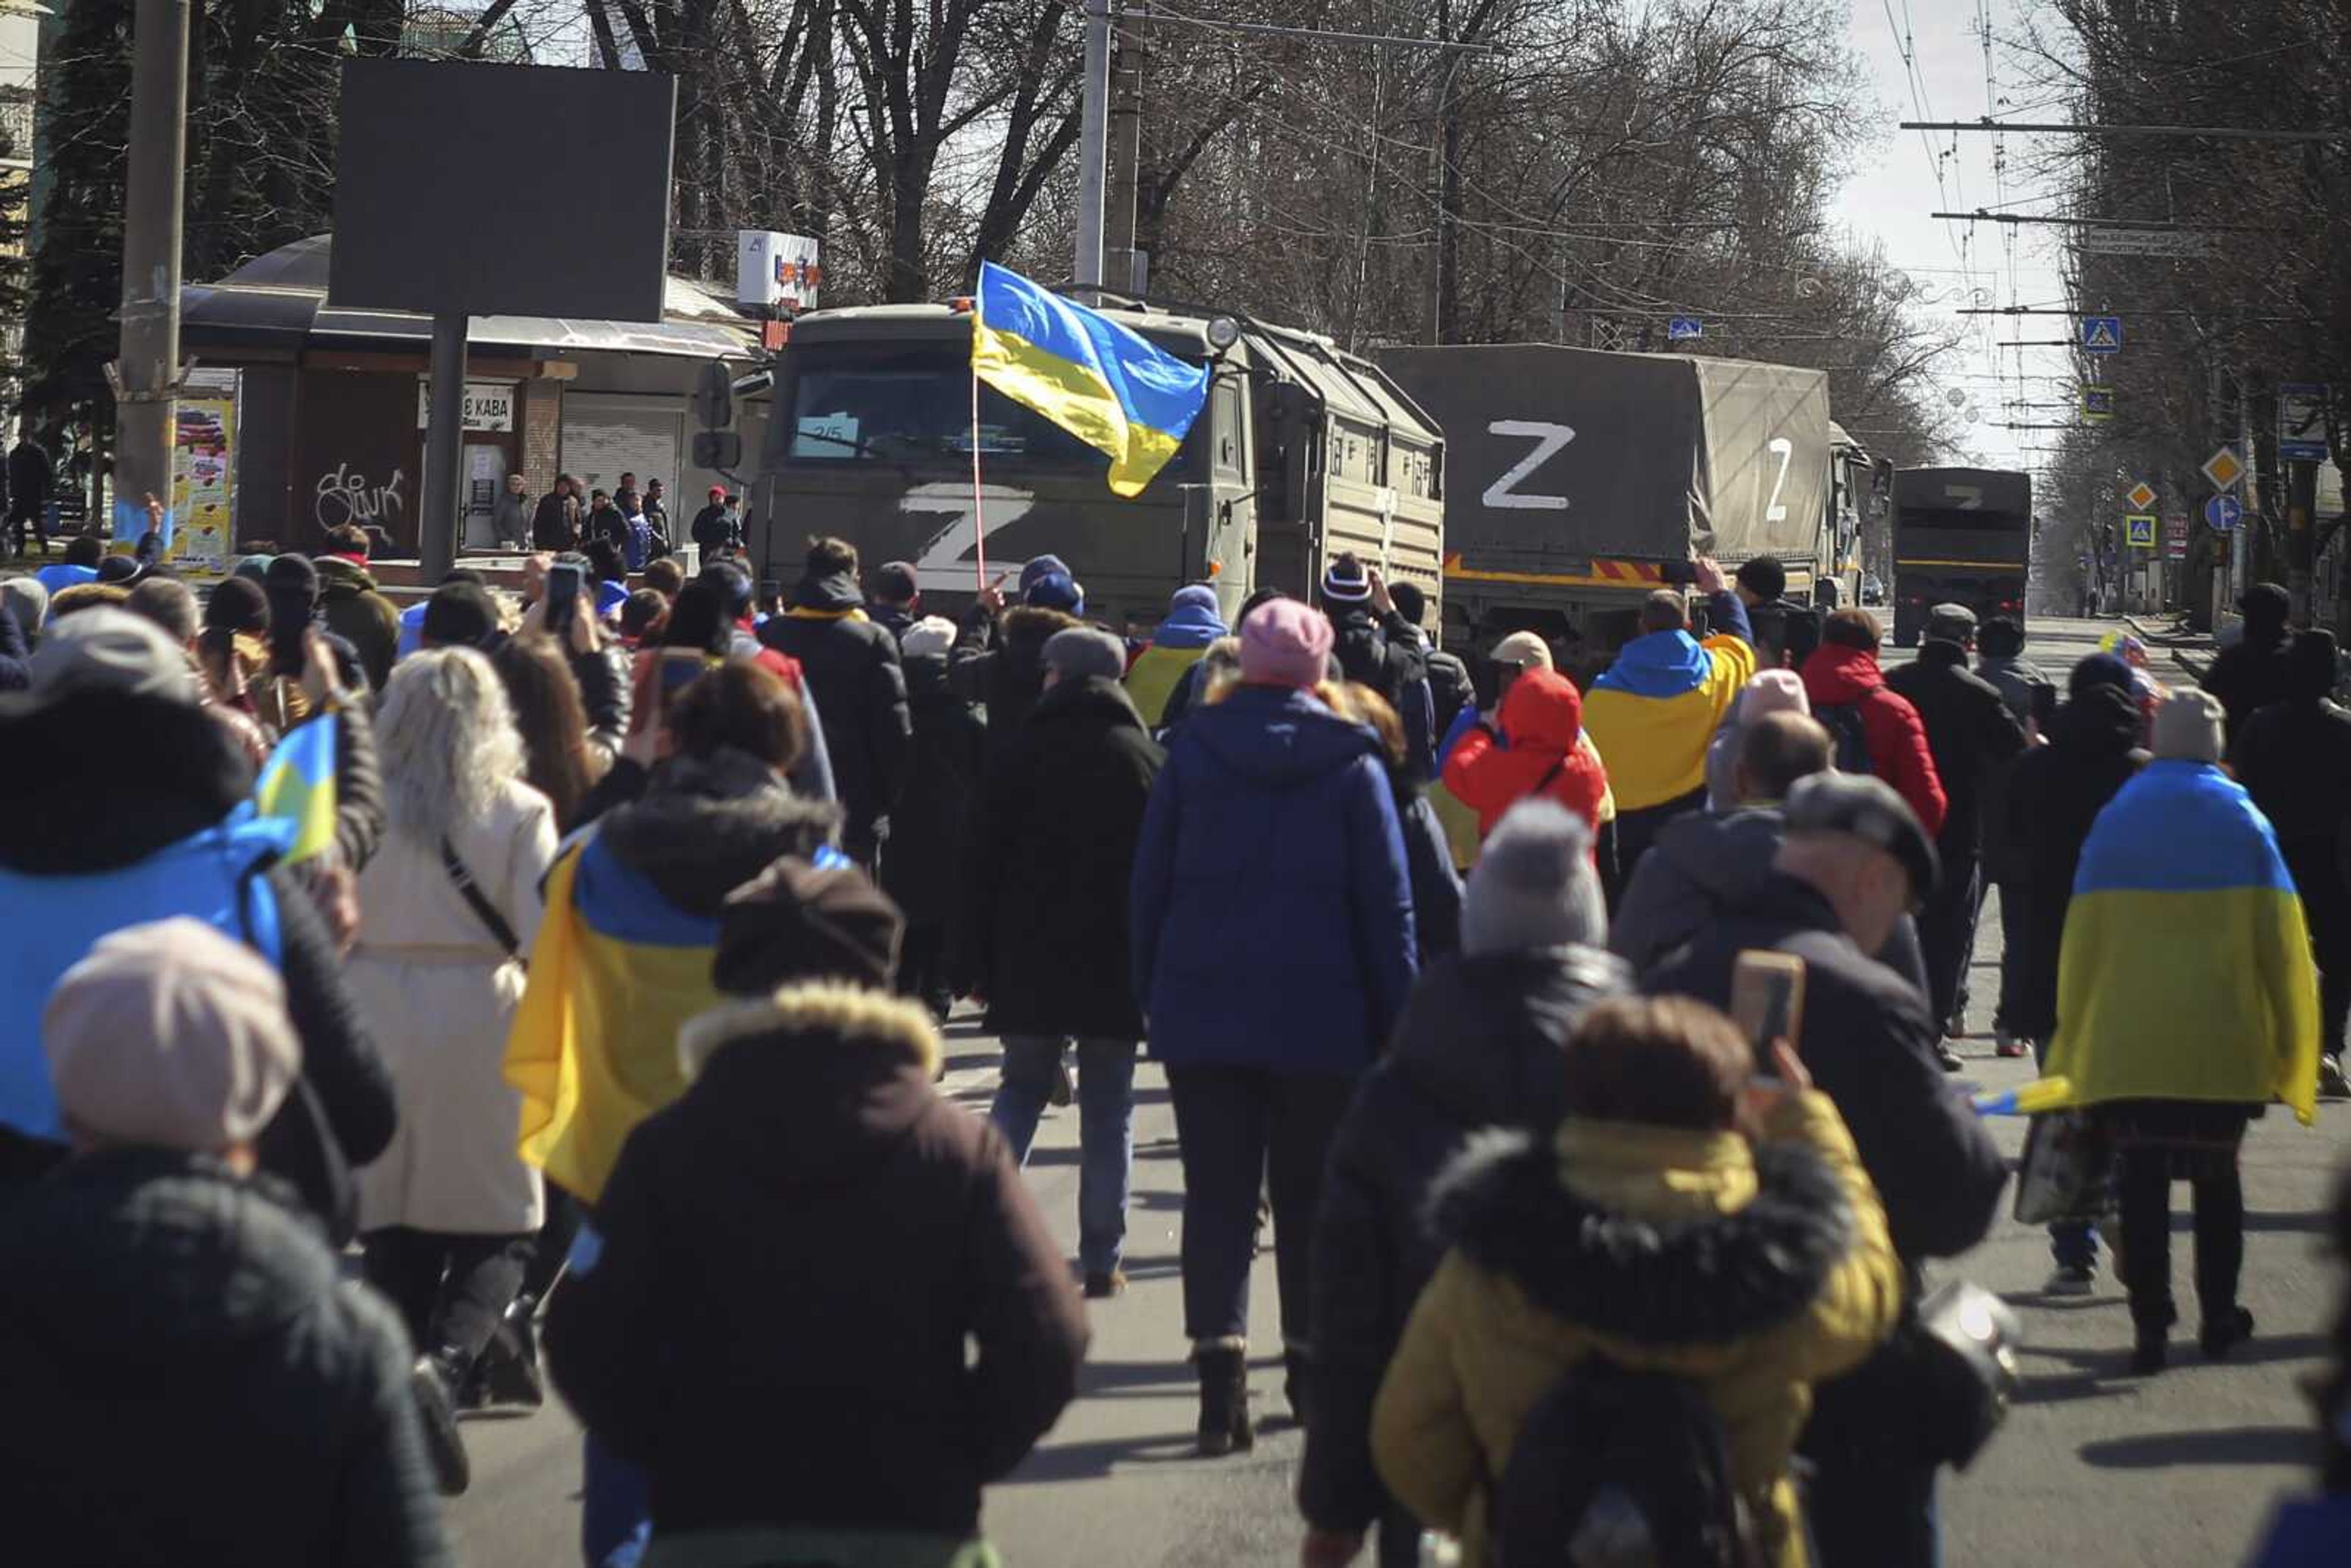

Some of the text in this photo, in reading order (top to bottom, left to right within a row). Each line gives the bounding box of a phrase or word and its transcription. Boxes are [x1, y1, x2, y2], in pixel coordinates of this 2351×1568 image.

[475, 399, 508, 418] КАВА
[1482, 420, 1577, 509] Z
[899, 482, 1035, 592] Z
